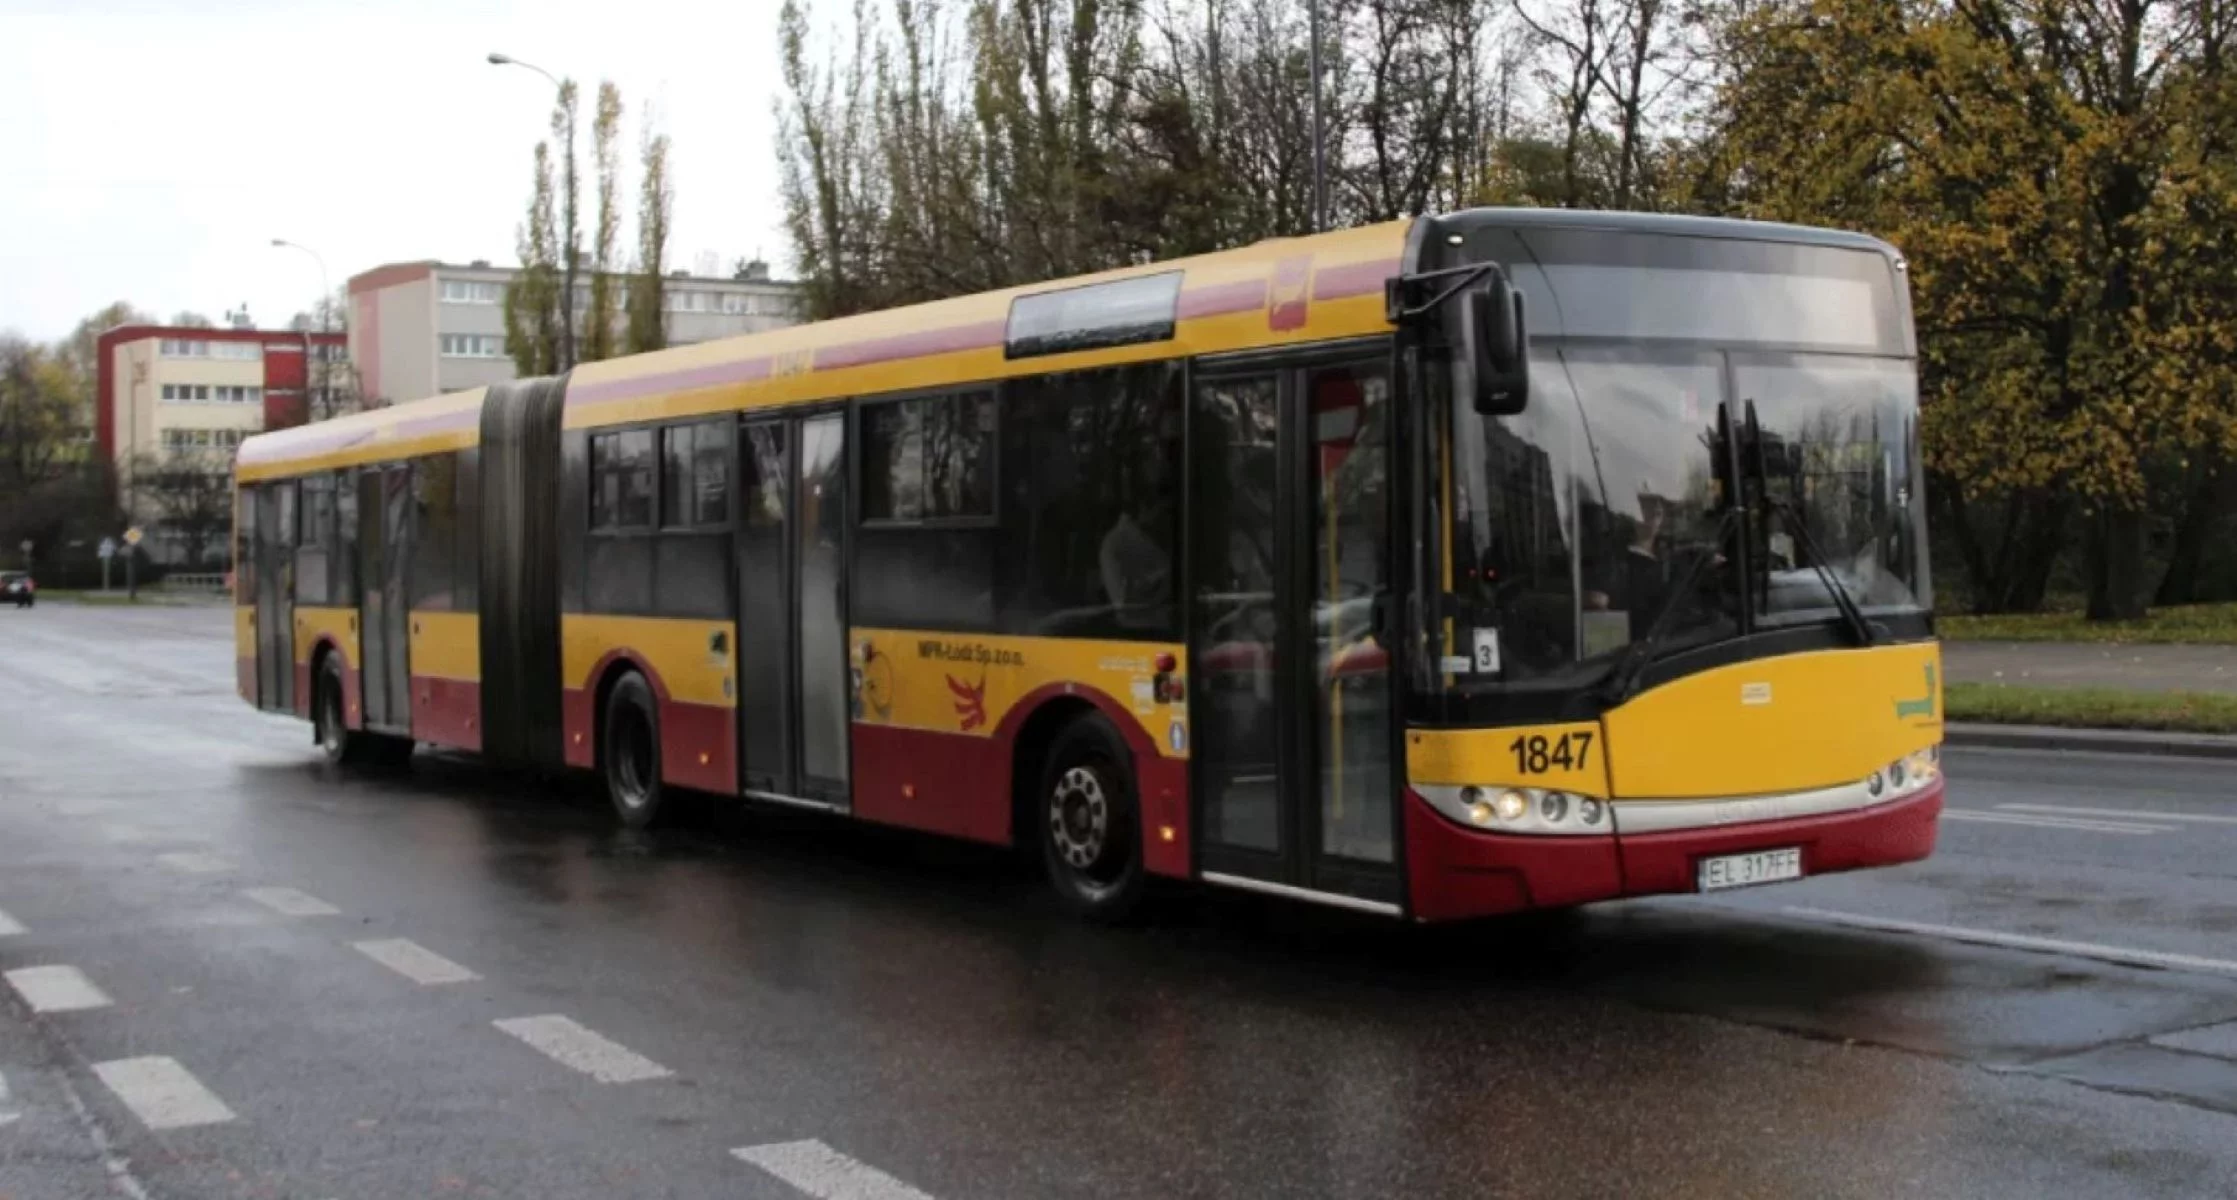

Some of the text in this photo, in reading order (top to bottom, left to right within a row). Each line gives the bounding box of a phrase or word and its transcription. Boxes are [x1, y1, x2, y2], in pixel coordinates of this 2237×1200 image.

[1480, 644, 1492, 667] 3
[1508, 731, 1593, 775] 1847
[1709, 860, 1735, 883] EL
